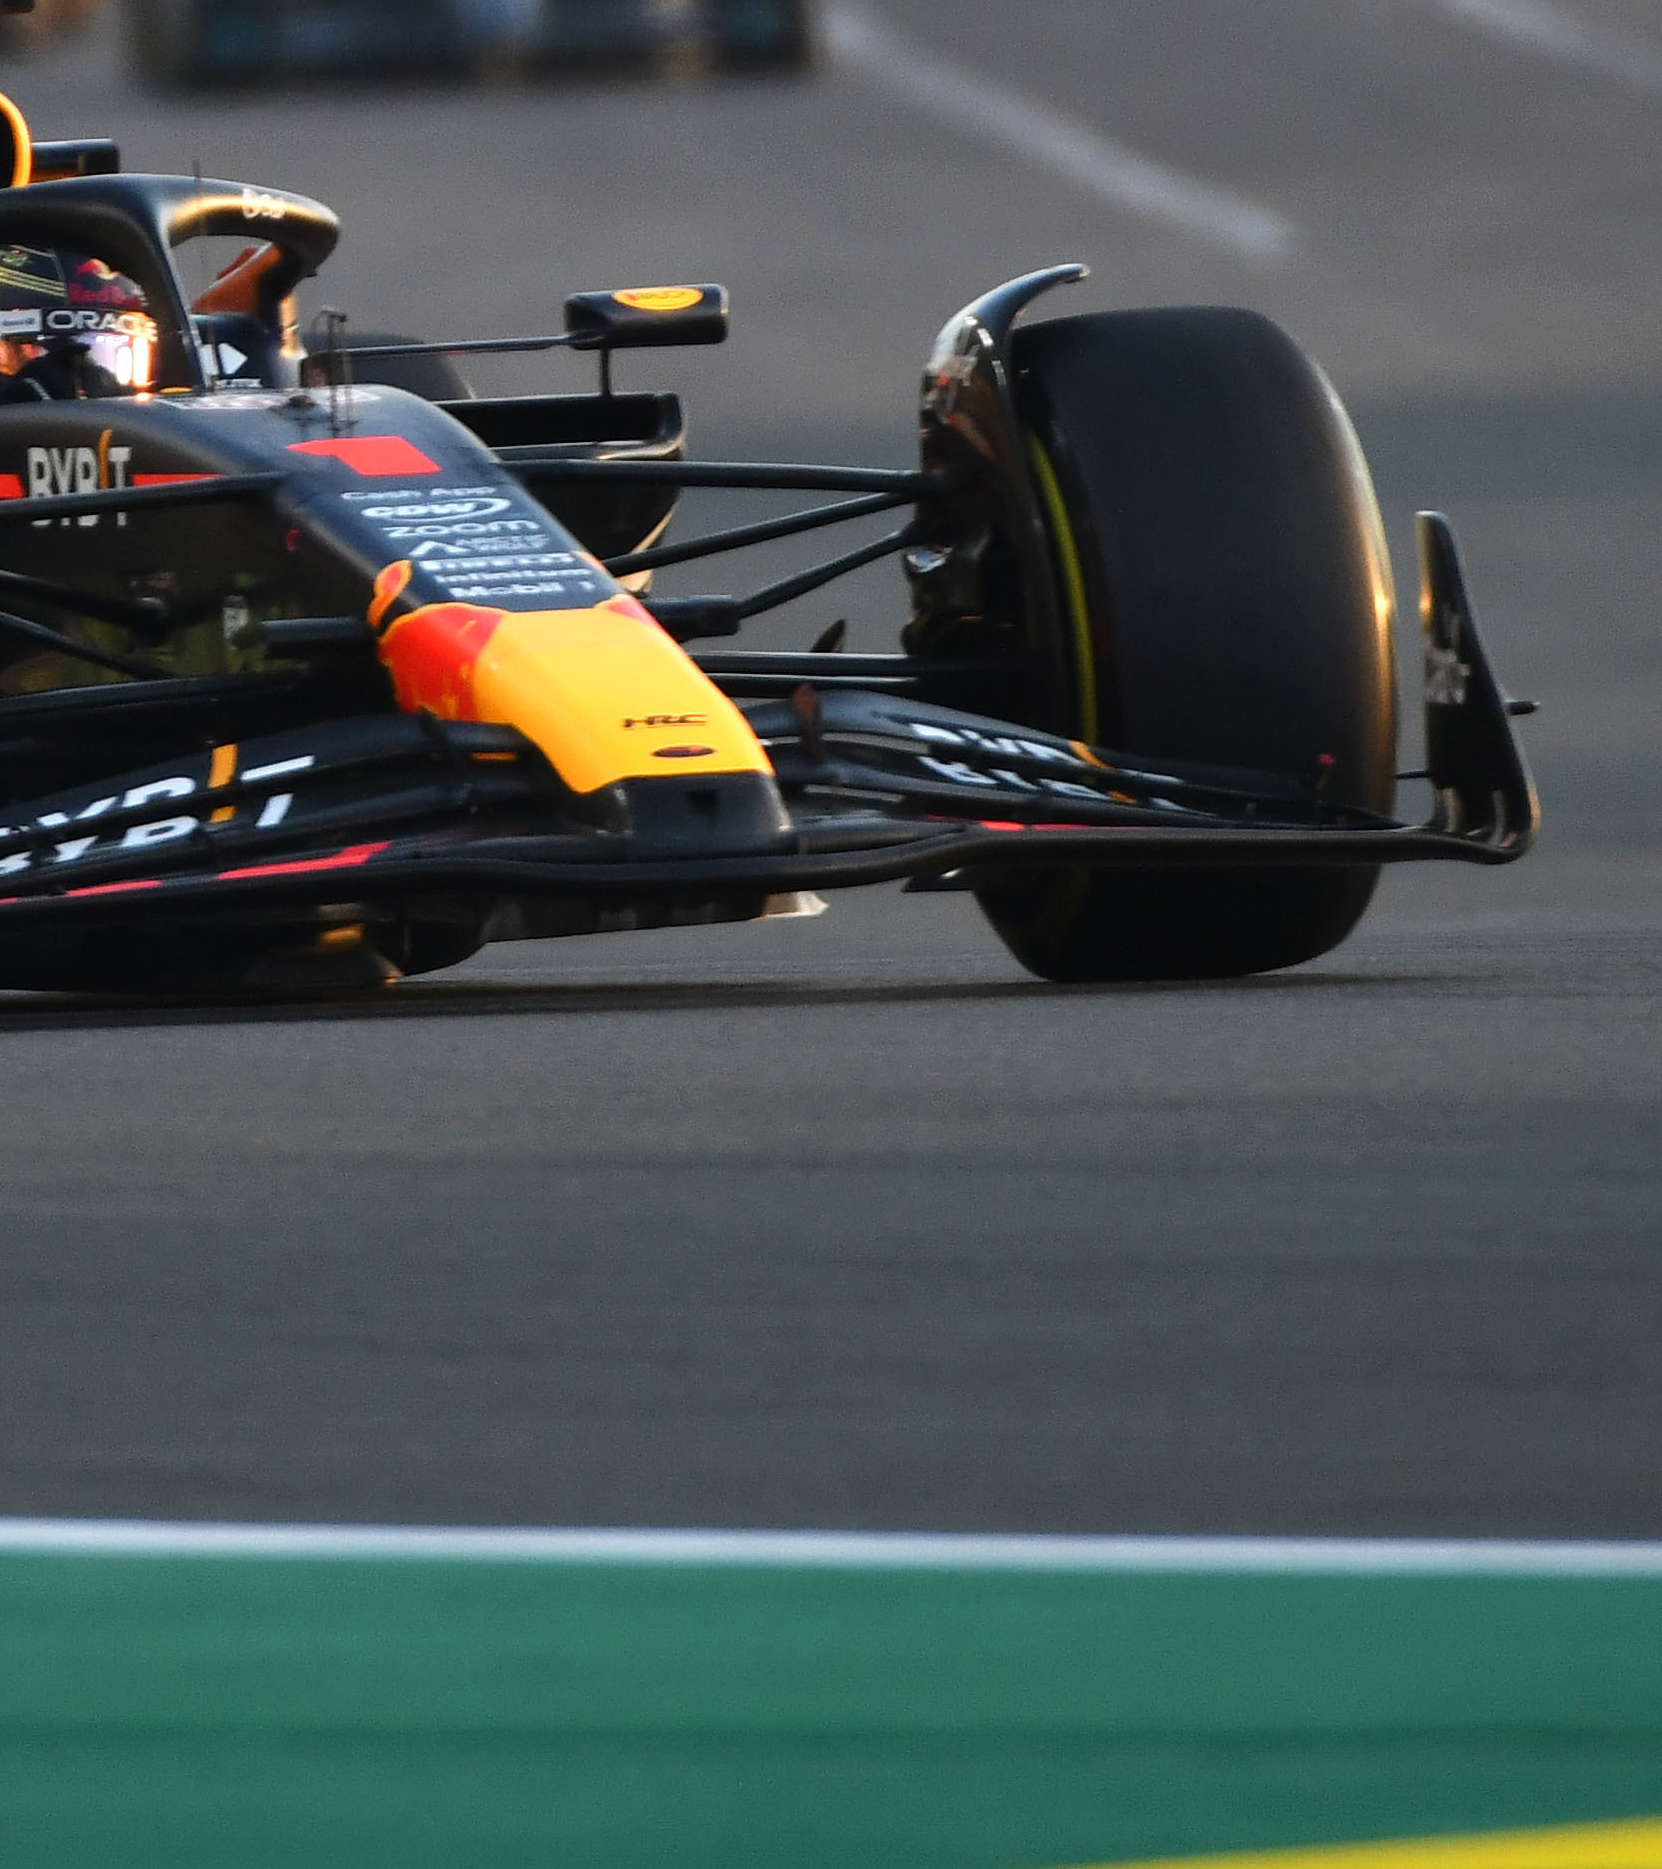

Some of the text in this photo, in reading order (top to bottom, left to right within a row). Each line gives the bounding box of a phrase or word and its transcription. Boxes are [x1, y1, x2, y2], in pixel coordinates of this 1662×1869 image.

[284, 435, 443, 477] 1
[381, 519, 541, 538] zoom
[449, 581, 566, 598] Mobil
